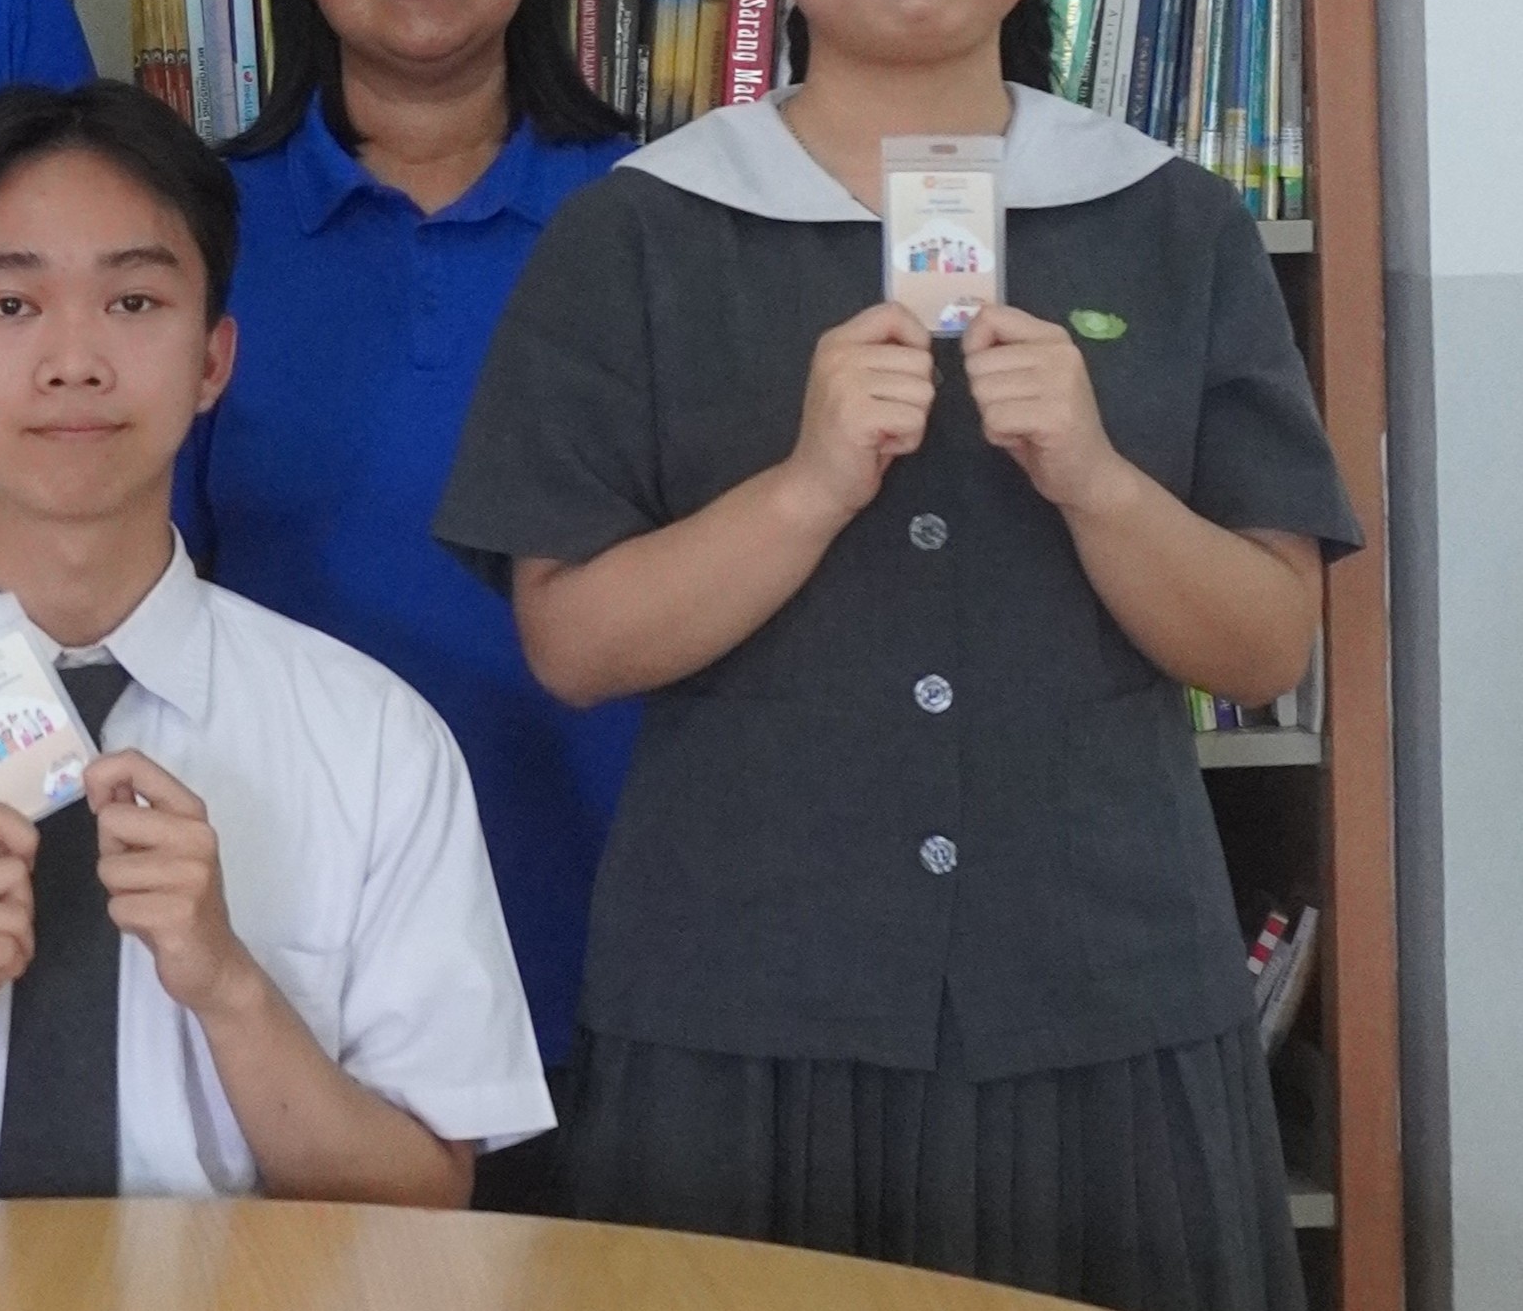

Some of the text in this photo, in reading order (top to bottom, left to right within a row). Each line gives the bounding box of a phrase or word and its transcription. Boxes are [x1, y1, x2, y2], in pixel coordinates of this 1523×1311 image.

[582, 17, 594, 48] SUATU
[582, 48, 594, 76] JALAN
[196, 47, 210, 118] MENYONGSONG
